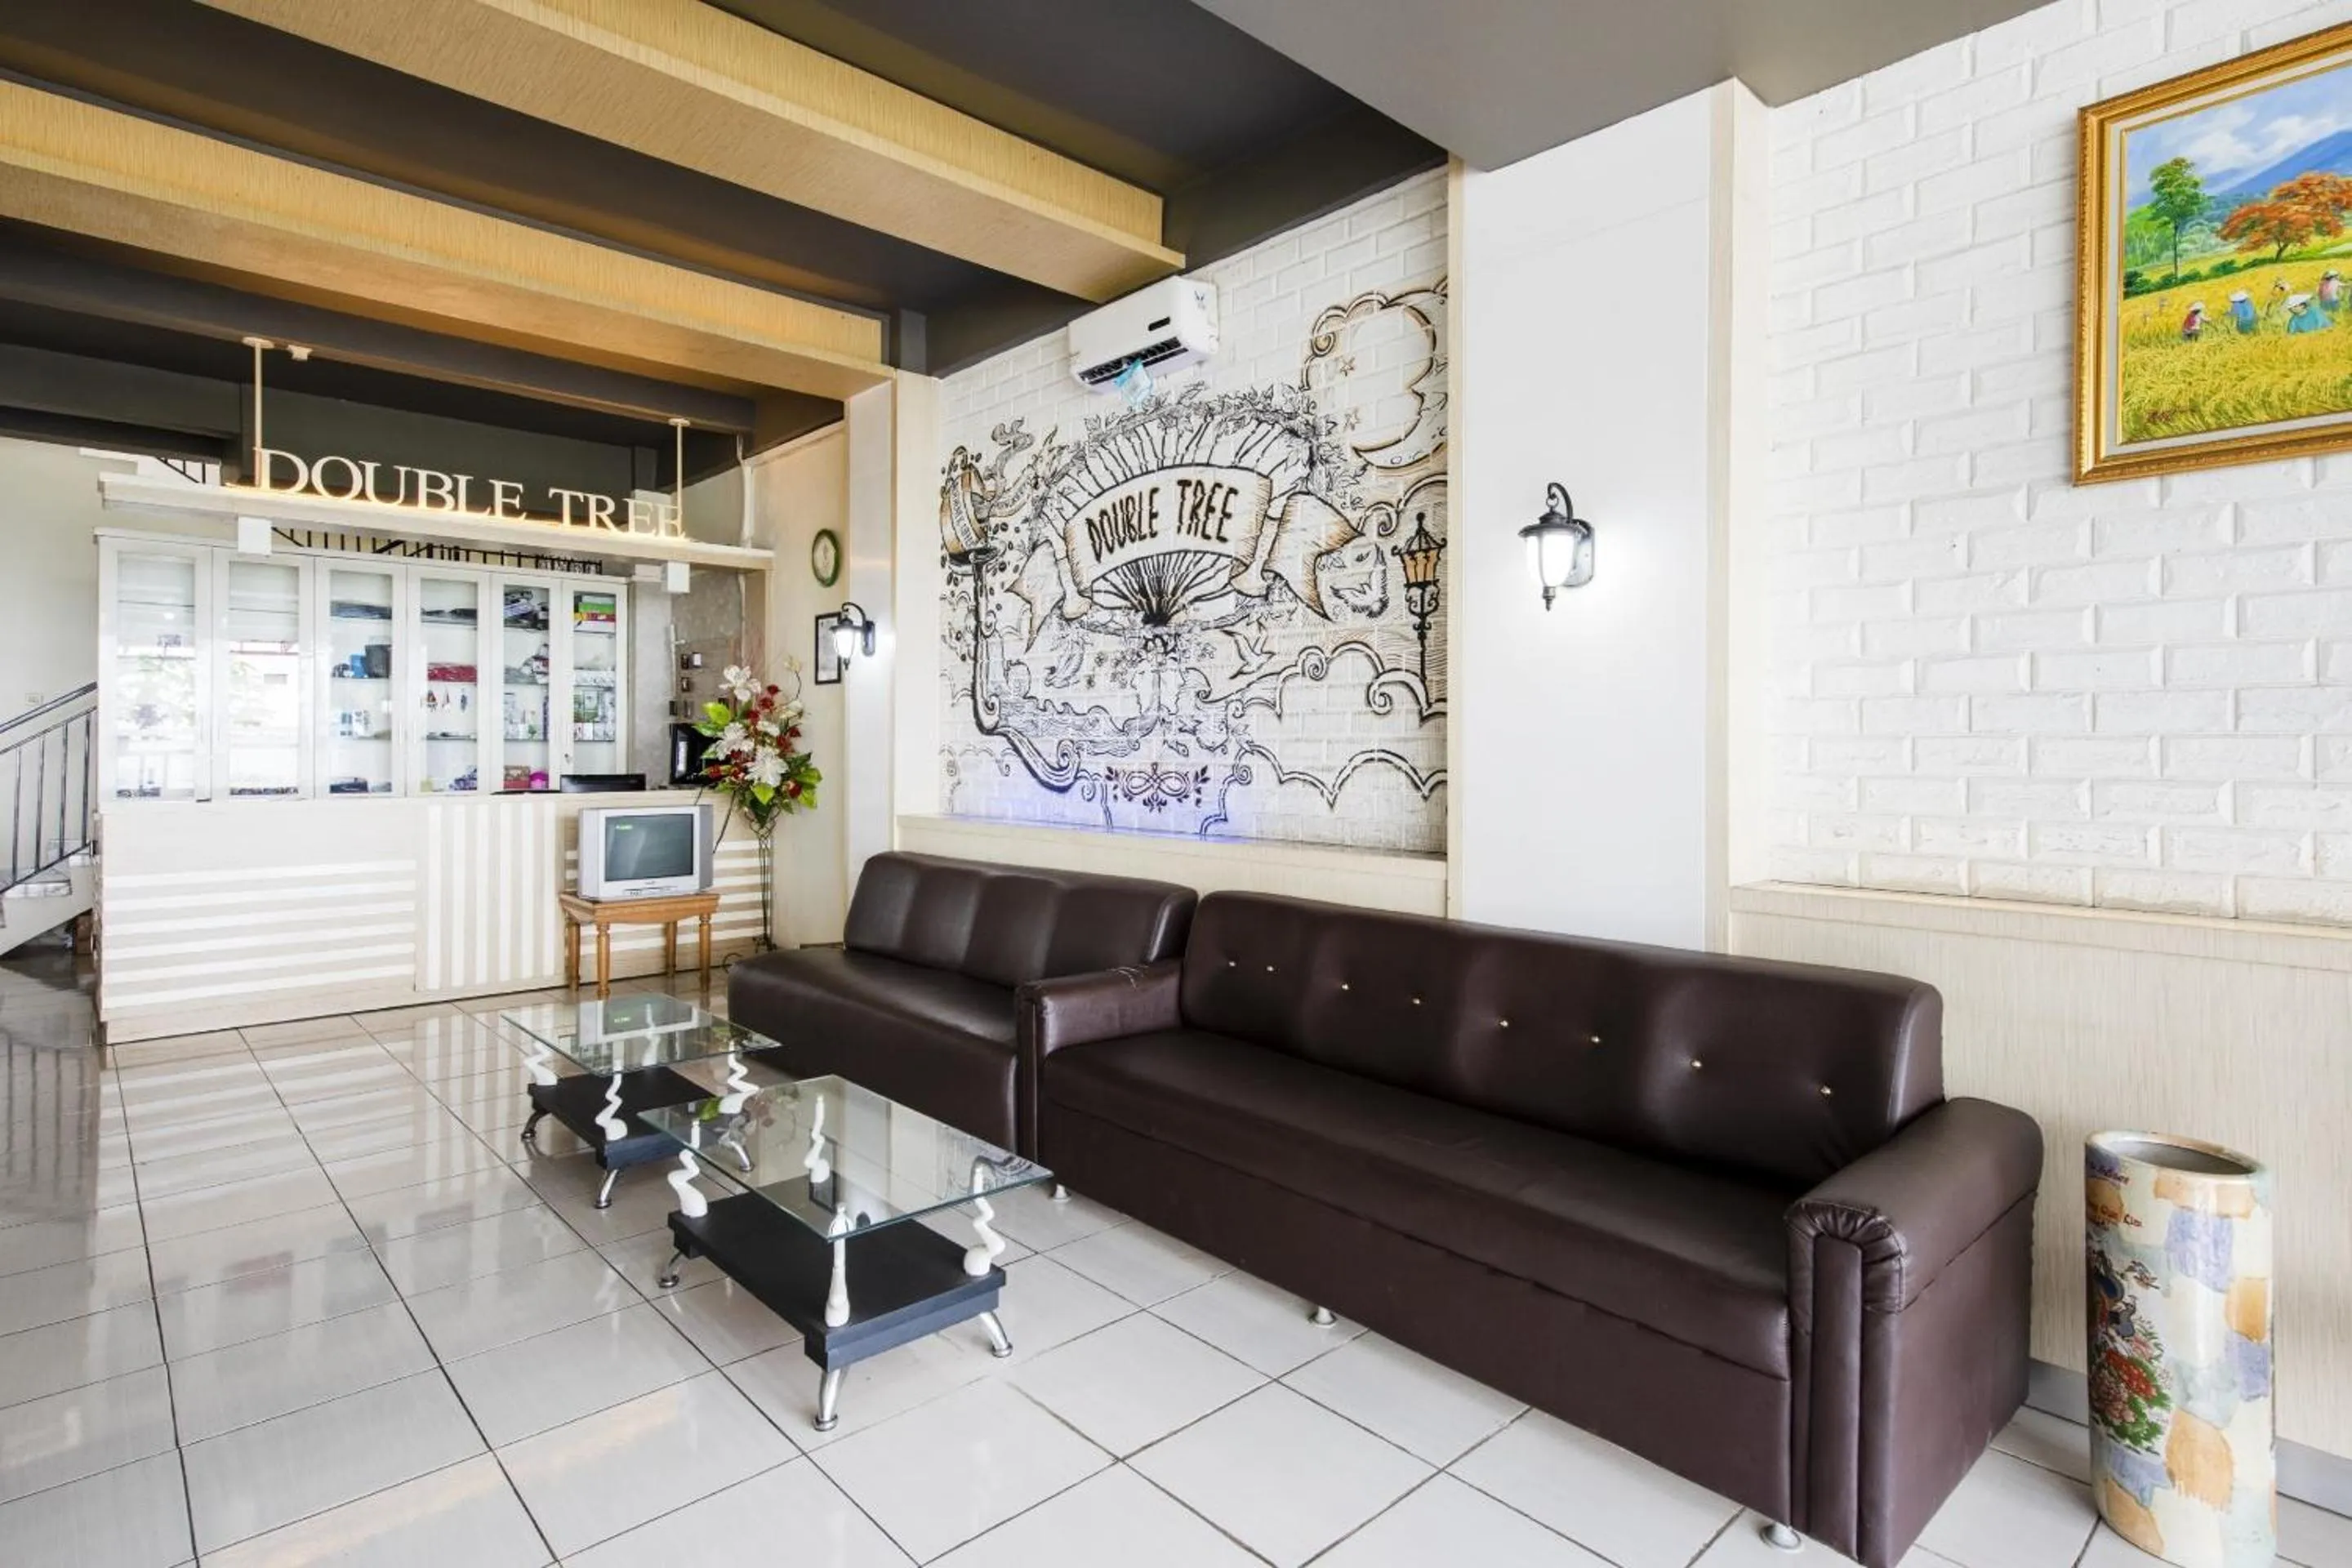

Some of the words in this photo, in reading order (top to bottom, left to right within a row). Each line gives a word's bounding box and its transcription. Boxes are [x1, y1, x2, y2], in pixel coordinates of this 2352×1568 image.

[255, 448, 526, 519] DOUBLE
[548, 488, 687, 539] TREE
[1085, 488, 1160, 564] DOUBLE
[1177, 479, 1239, 543] TREE
